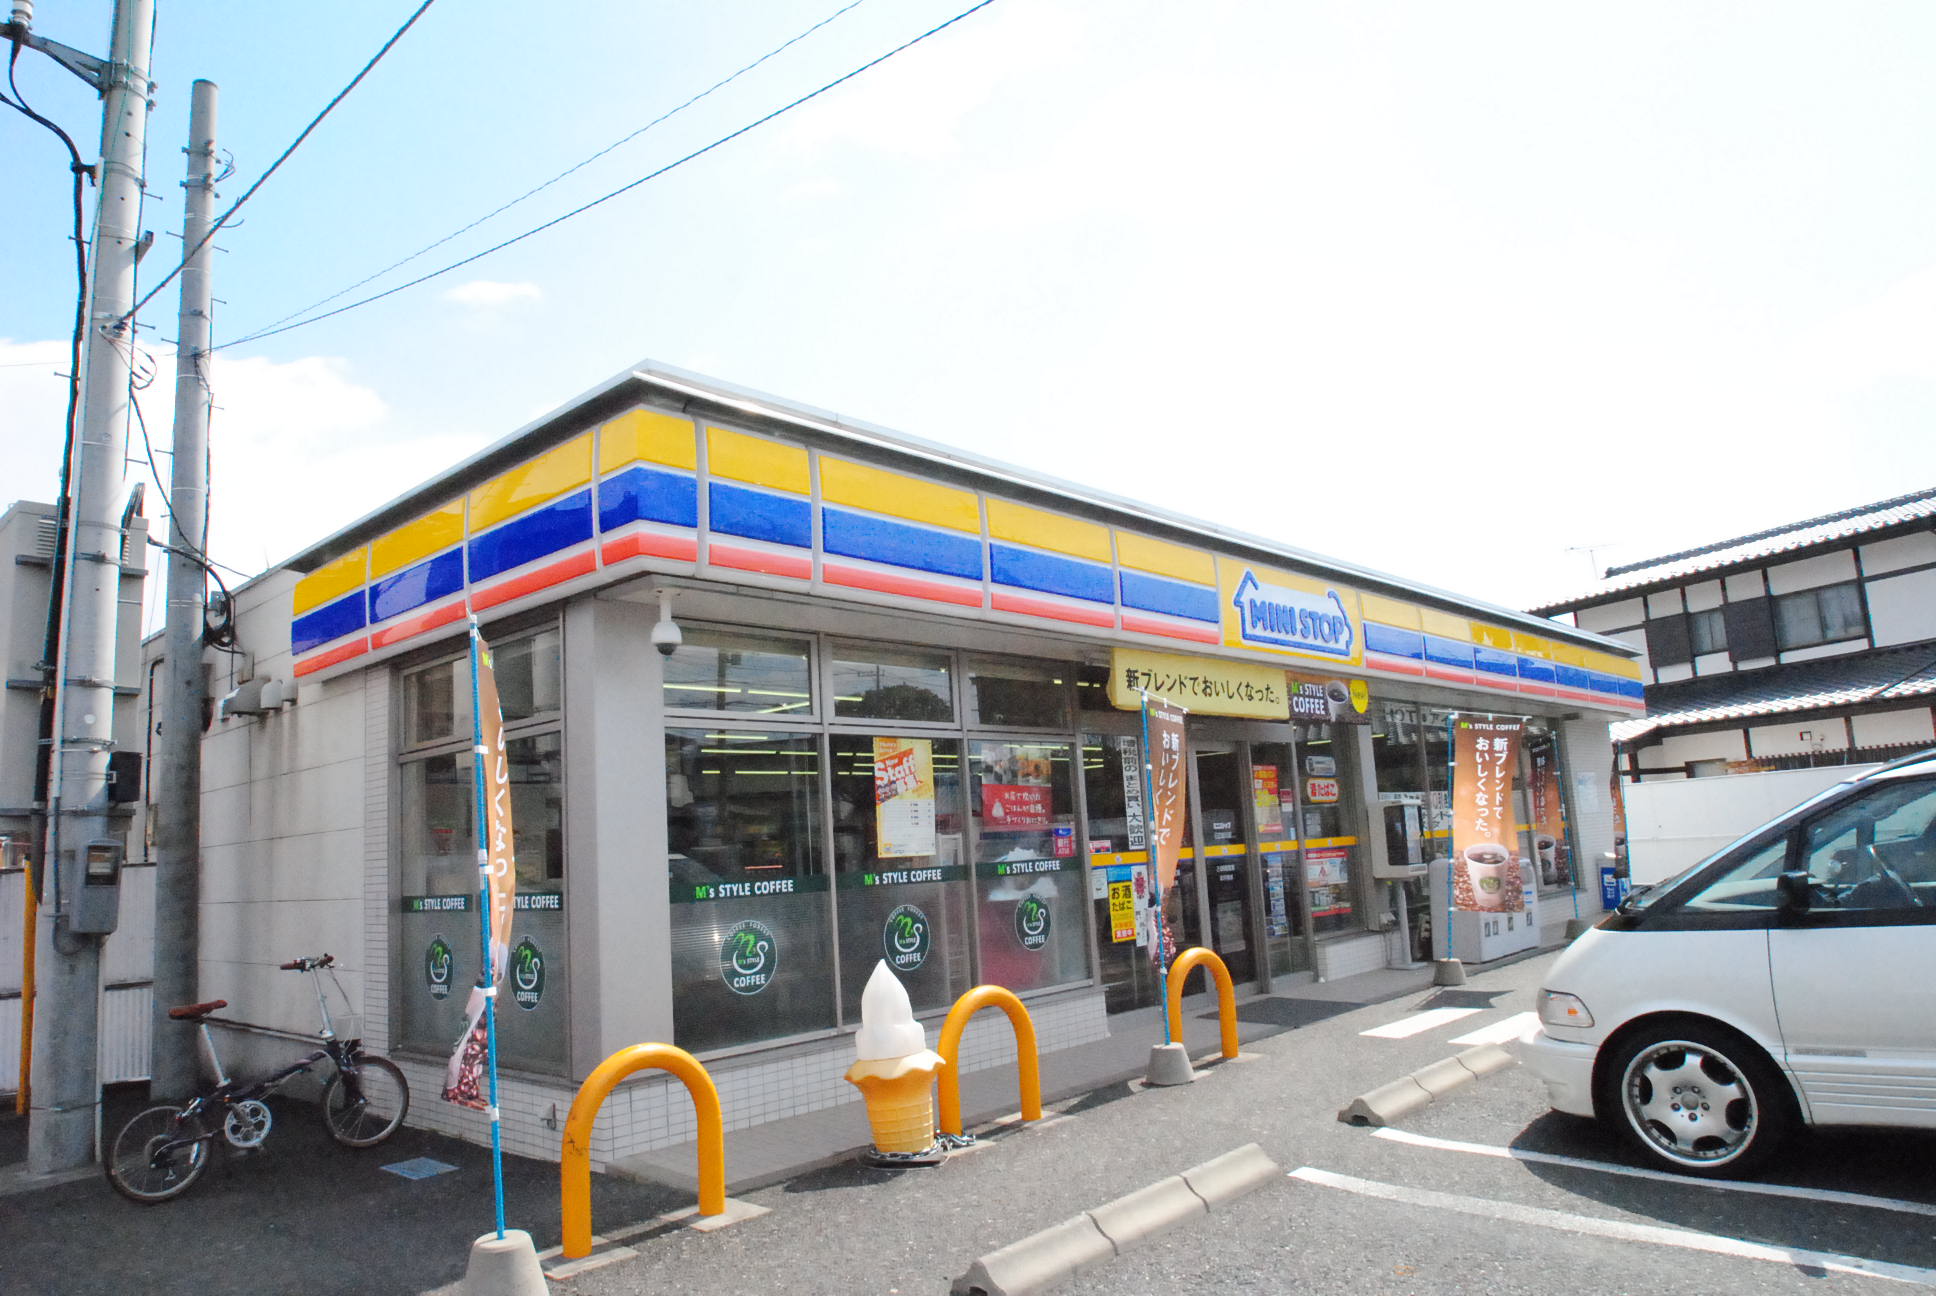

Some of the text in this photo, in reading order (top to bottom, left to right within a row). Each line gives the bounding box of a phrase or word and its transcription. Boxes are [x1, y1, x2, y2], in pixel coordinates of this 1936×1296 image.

[1250, 599, 1345, 644] MINI STOP
[1125, 667, 1281, 705] 新ブレンドでおいしくなった。
[1304, 683, 1324, 697] STYLE
[1292, 696, 1326, 715] COFFEE
[1474, 723, 1494, 731] STYLE
[1495, 723, 1521, 731] COFFEE
[1492, 736, 1509, 820] 新ブレンドで
[1158, 731, 1180, 846] 新ブレンドで
[1474, 736, 1492, 838] おいしくなった。
[997, 860, 1061, 875] M's STYLE COFFEE
[864, 869, 942, 886] M's STYLE COFFEE
[695, 879, 794, 898] M's STYLE COFFEE
[424, 898, 442, 911] STYLE
[442, 897, 465, 910] COFFEE
[513, 895, 559, 909] TYLE COFFEE
[1024, 934, 1045, 945] COFFEE
[895, 952, 922, 964] COFFEE
[733, 973, 766, 988] COFFEE
[516, 990, 539, 1003] COFFEE
